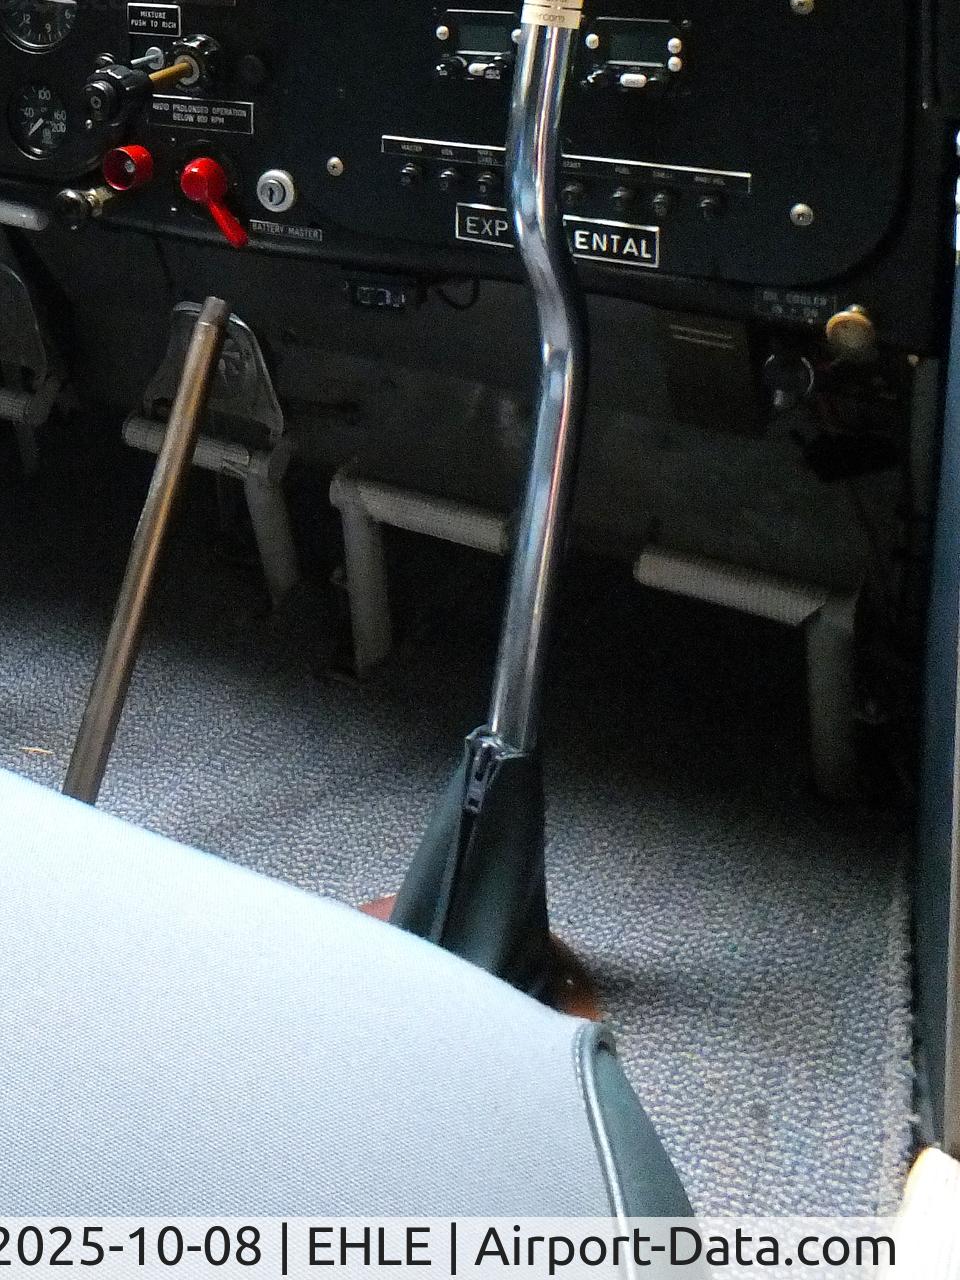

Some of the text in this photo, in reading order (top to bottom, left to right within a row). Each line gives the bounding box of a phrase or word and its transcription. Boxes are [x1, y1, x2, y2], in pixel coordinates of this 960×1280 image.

[139, 10, 166, 20] MIXTURE
[130, 19, 177, 30] PUSH TO RICH
[172, 103, 210, 114] PROLONGED
[211, 106, 247, 118] OPERATION
[172, 113, 195, 124] BELOW
[251, 222, 322, 241] BATTERY MASTER
[466, 216, 652, 260] EXPENTAL
